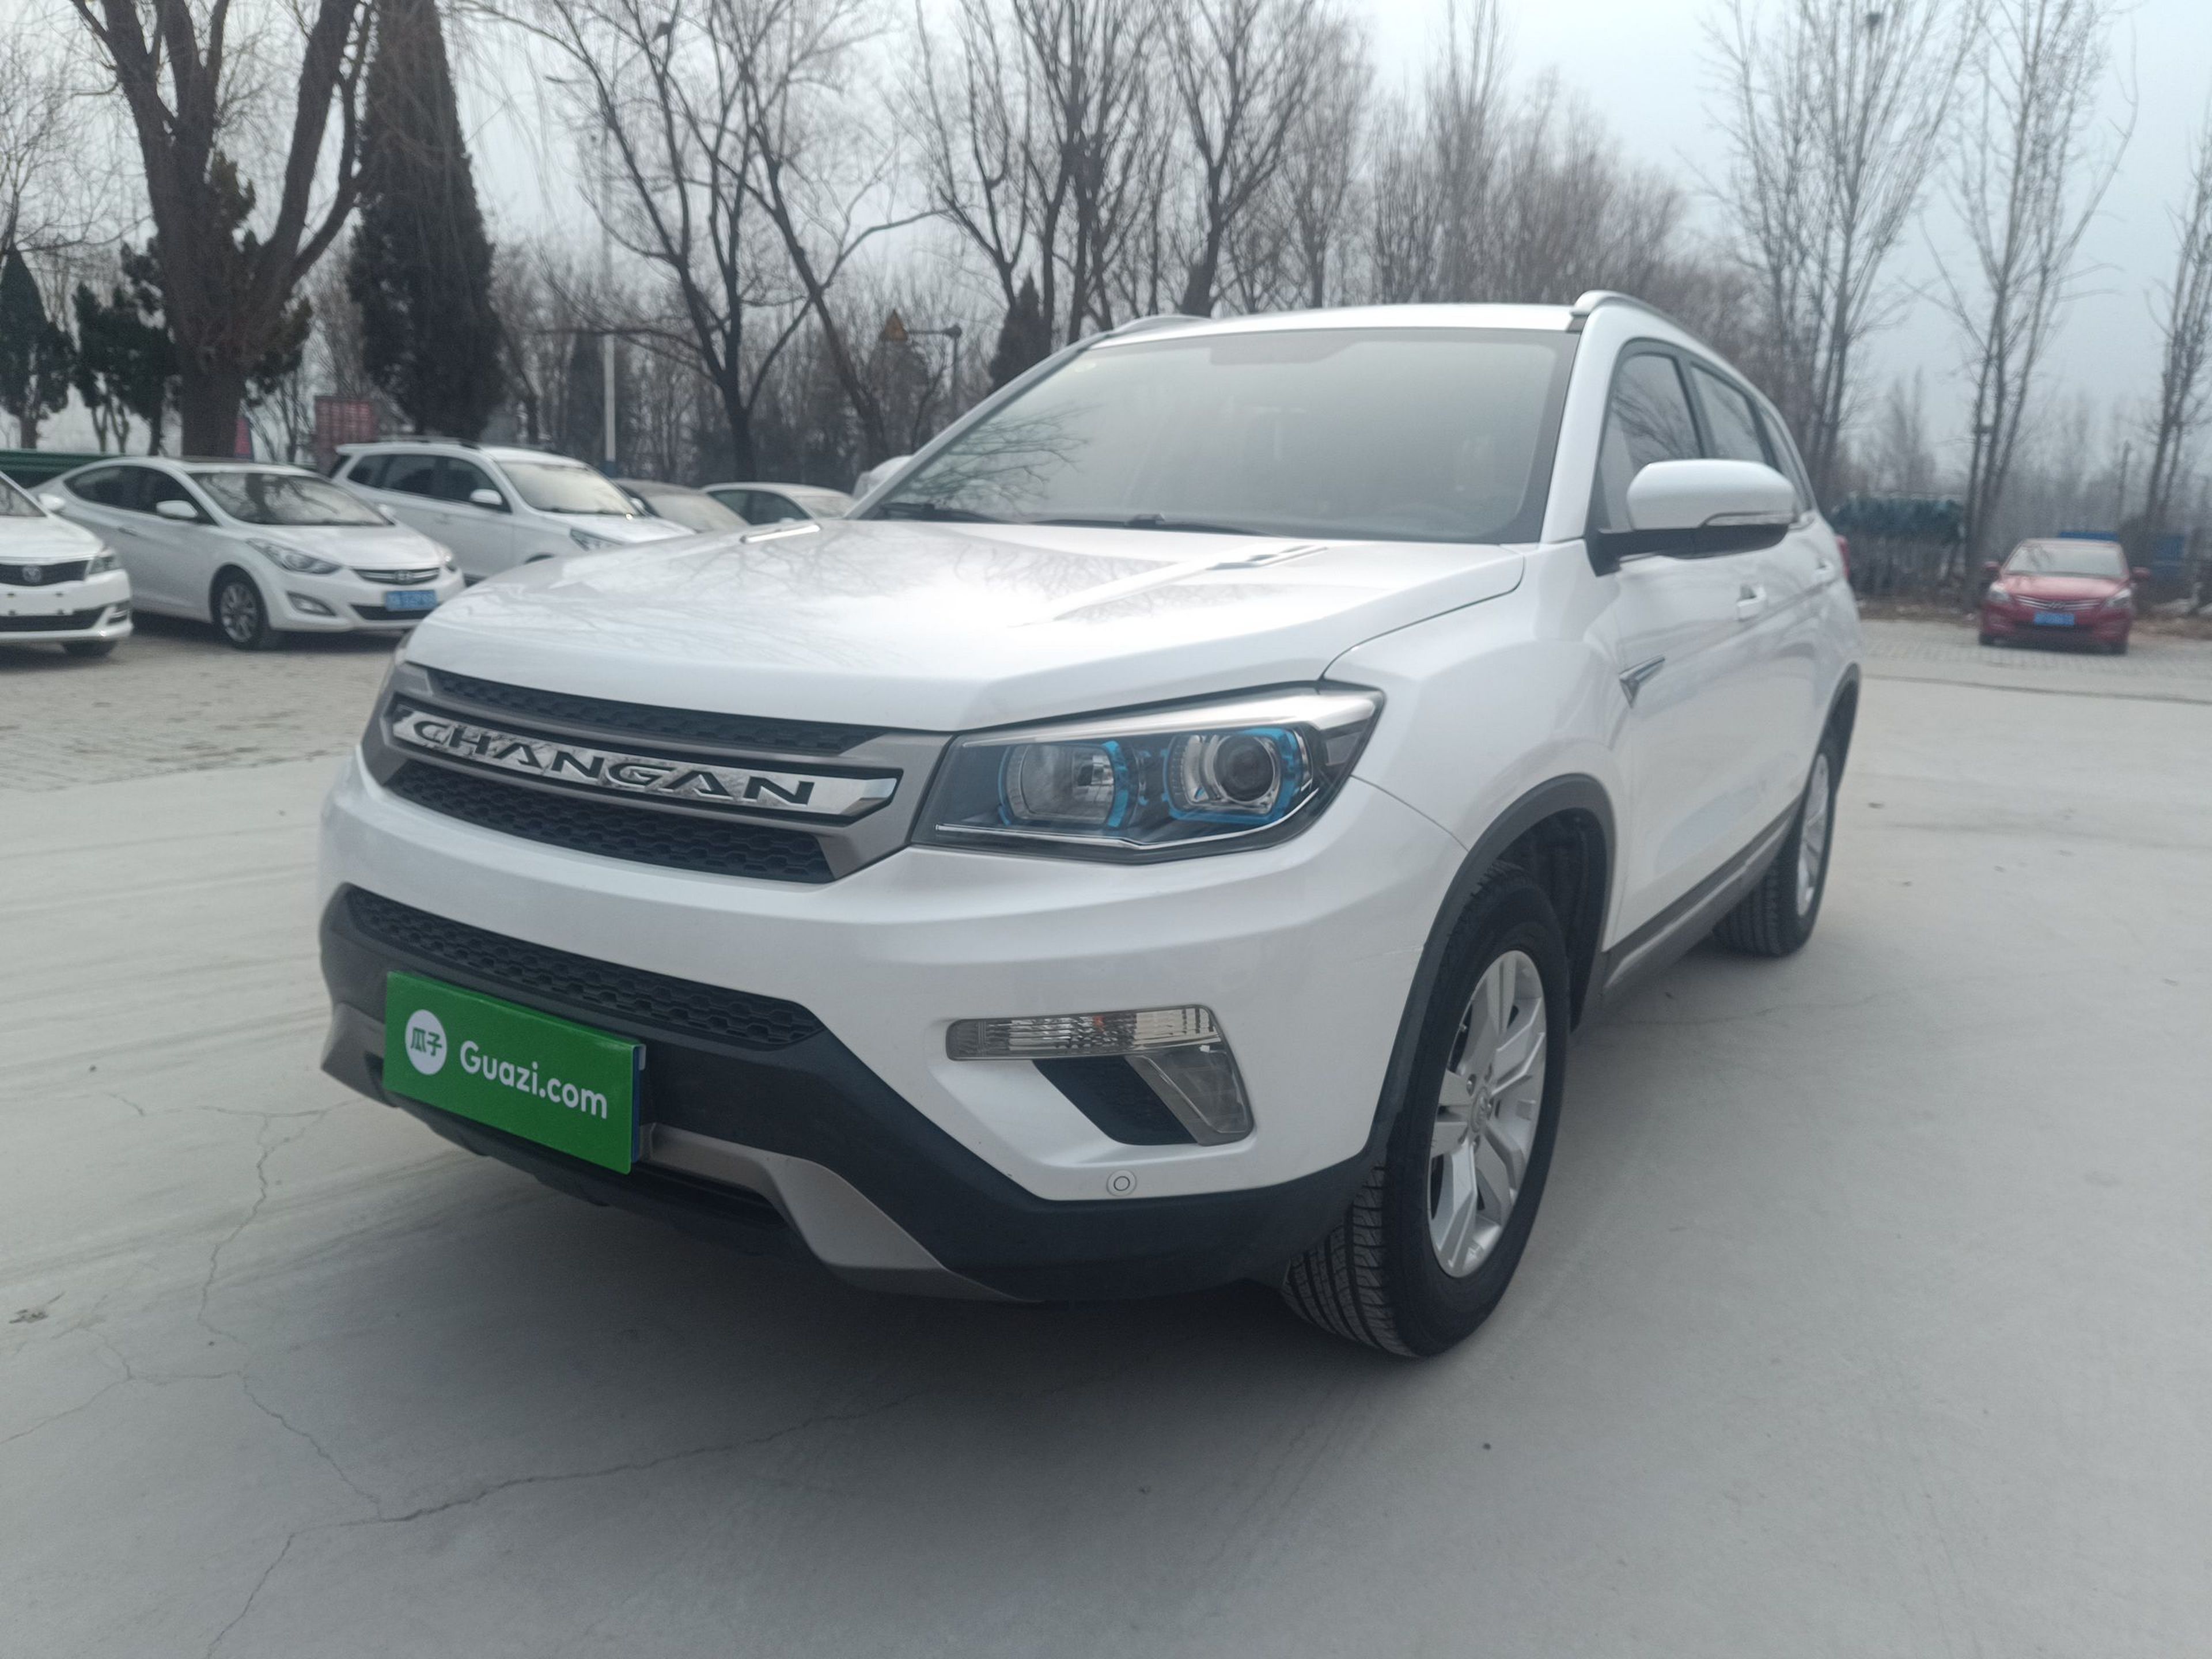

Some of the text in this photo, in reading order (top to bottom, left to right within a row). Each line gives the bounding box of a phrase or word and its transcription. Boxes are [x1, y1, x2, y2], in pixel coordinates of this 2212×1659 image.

[414, 720, 815, 805] CHANGAN
[411, 1028, 442, 1056] 瓜子
[460, 1040, 607, 1119] Guazi.com
